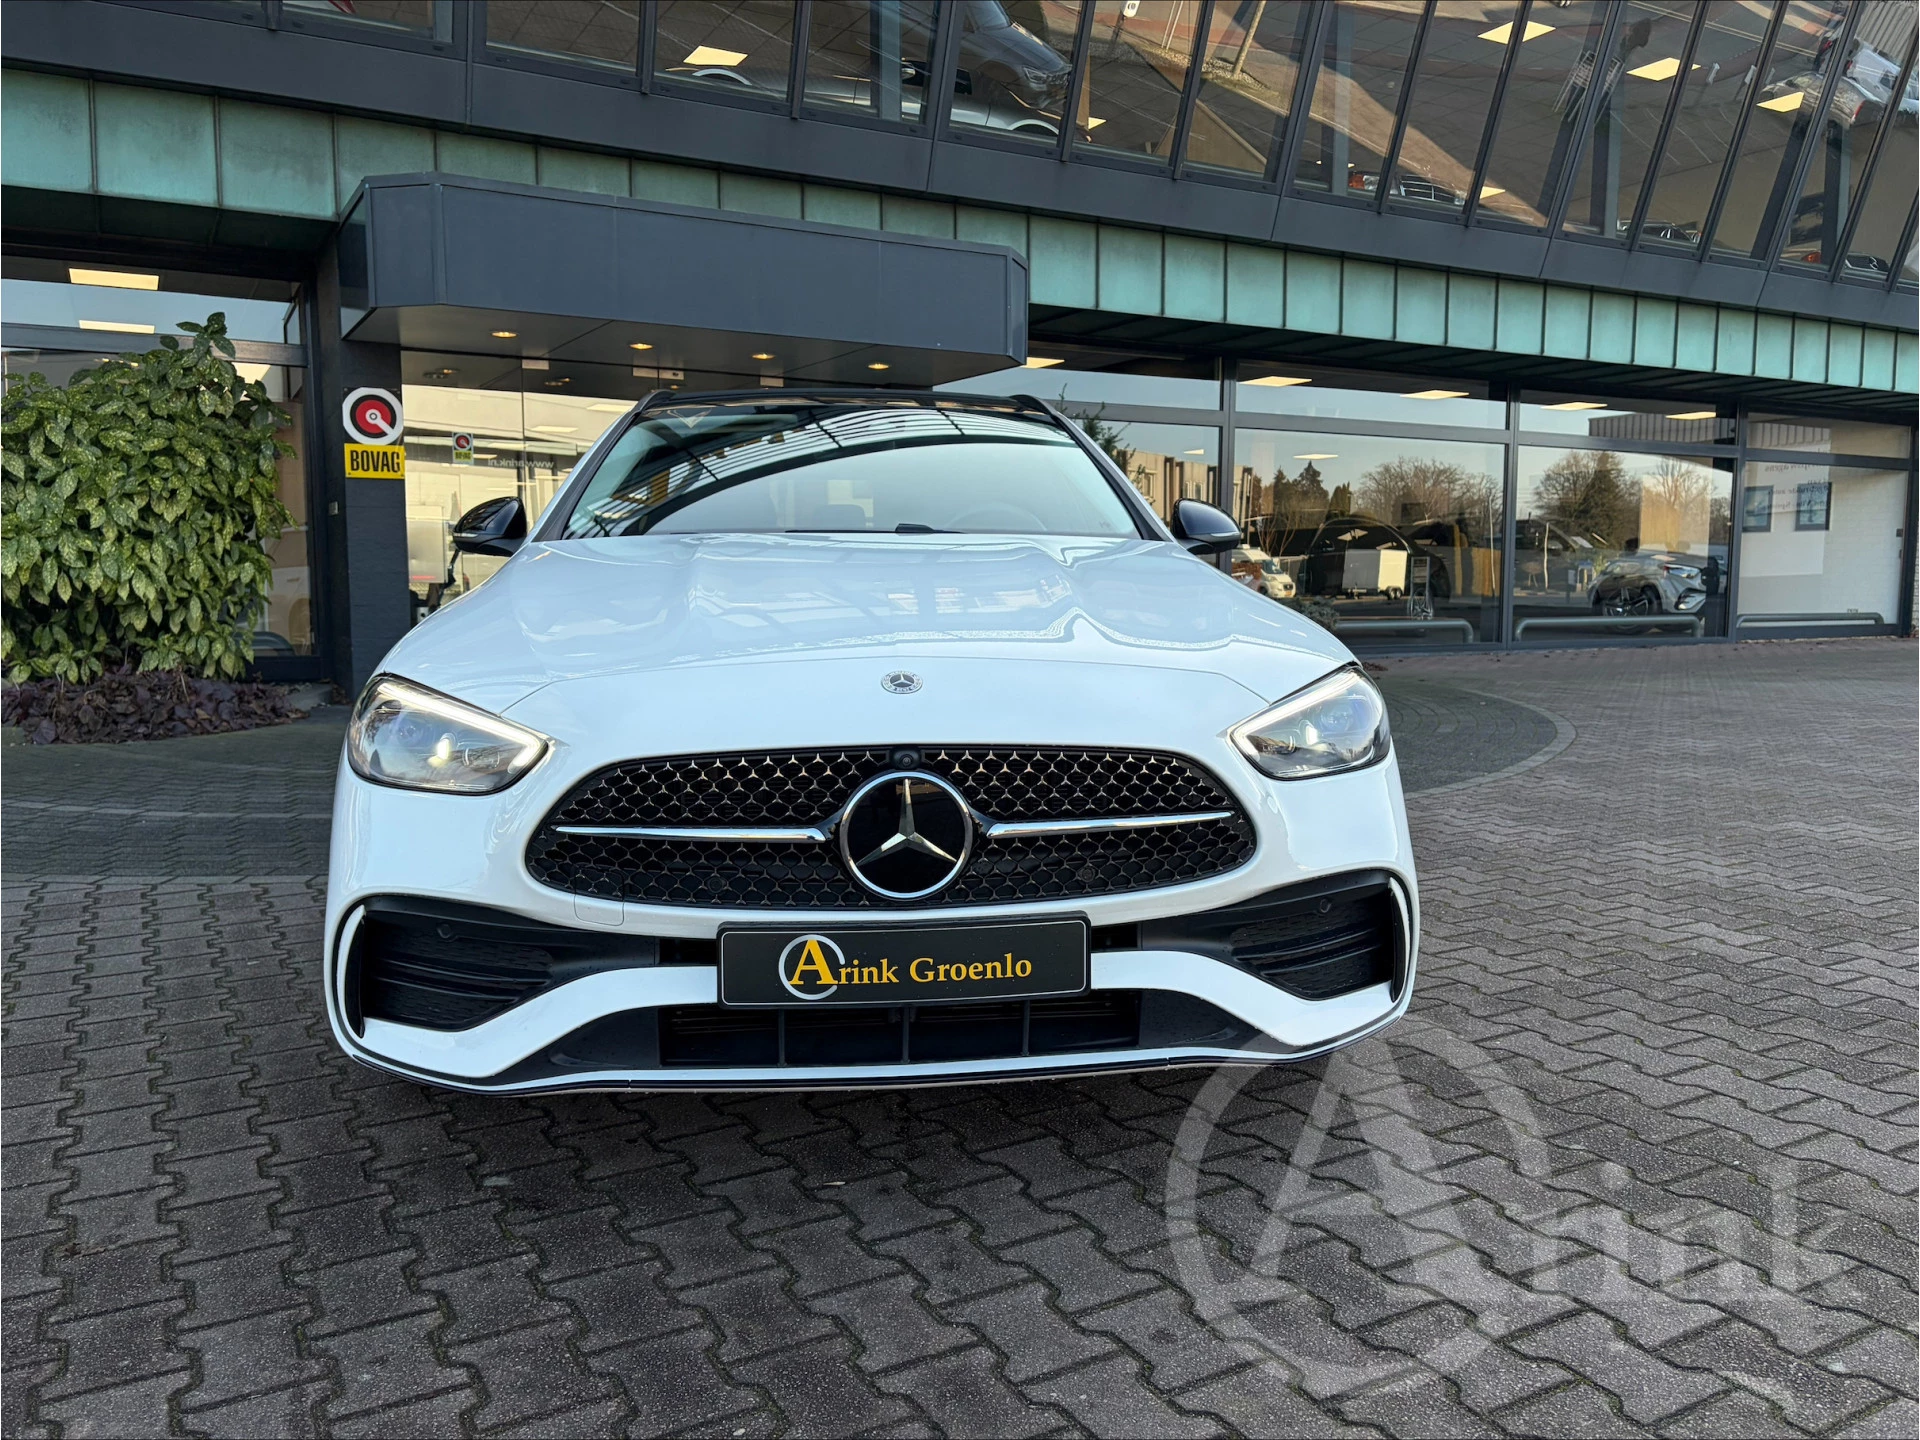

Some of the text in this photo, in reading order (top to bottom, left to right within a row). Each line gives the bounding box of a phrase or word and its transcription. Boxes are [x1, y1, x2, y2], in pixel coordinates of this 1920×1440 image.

[350, 449, 401, 473] BOVAG
[790, 938, 1032, 986] Arink Groenlo
